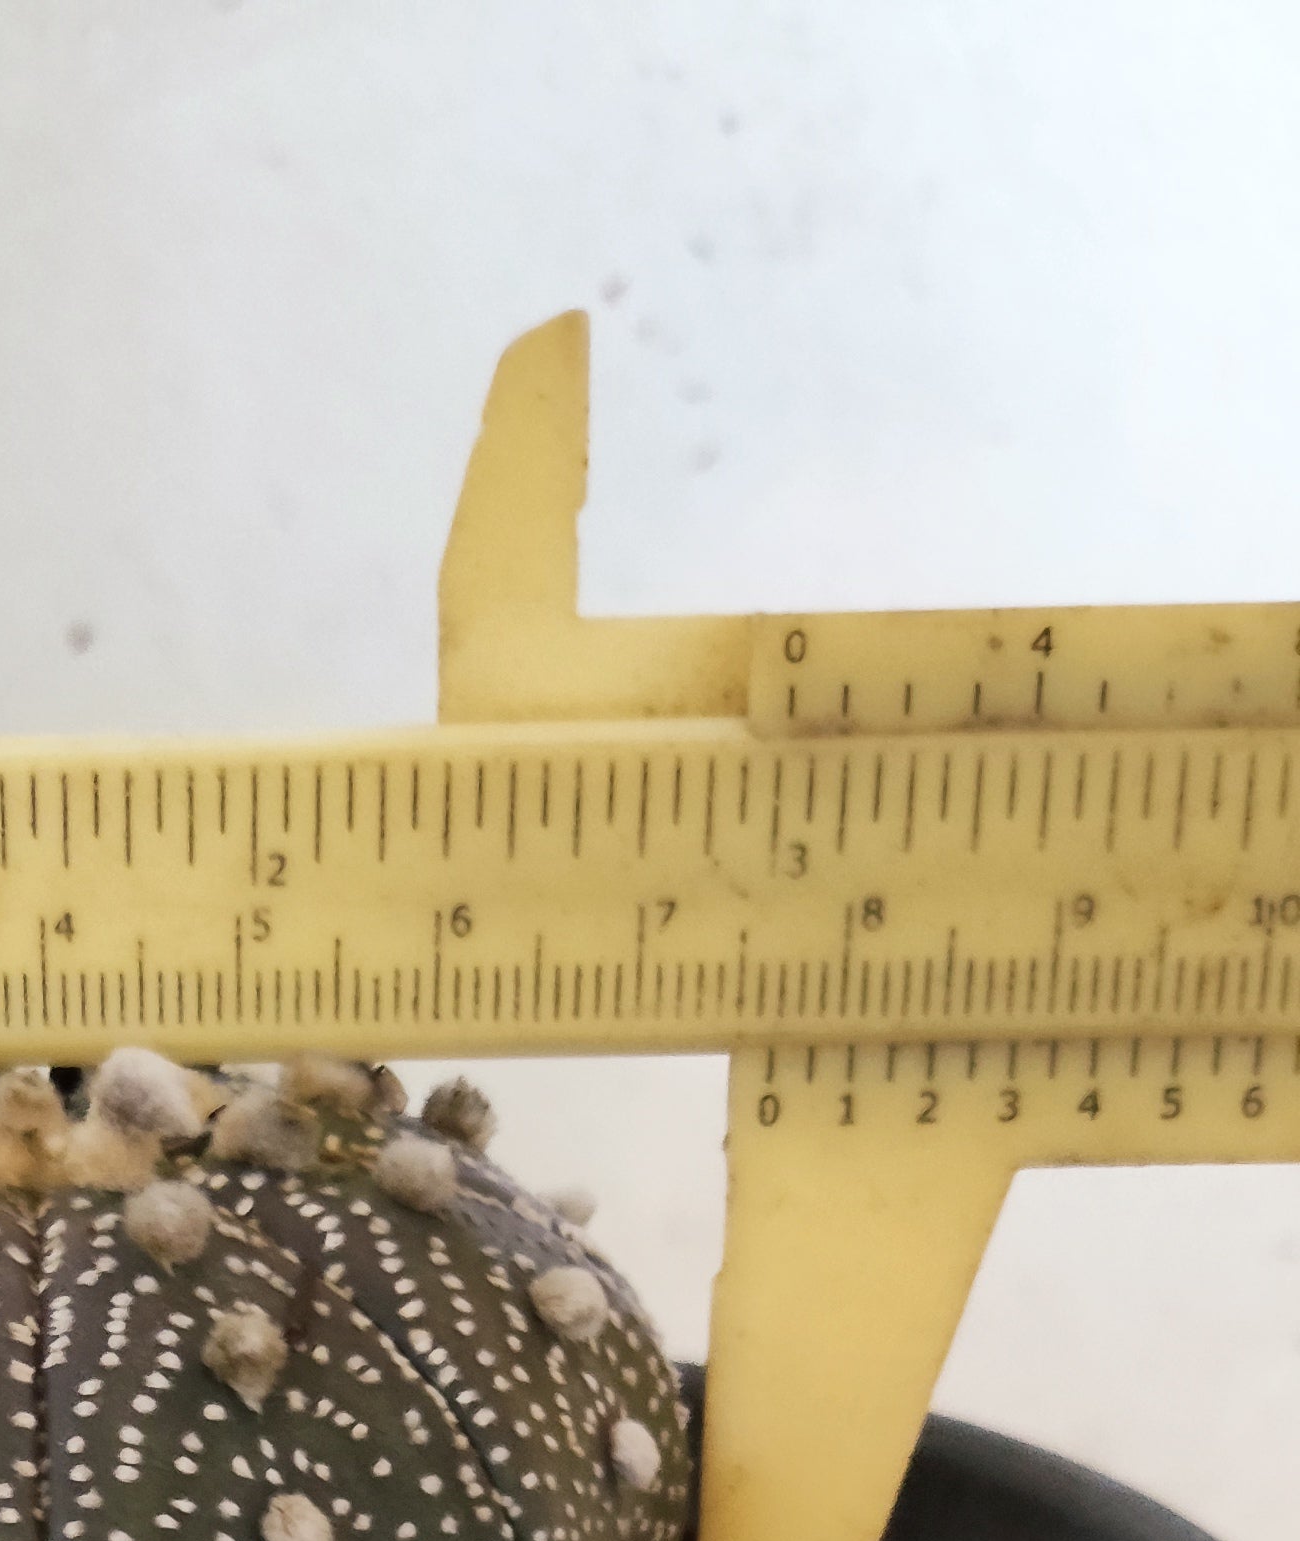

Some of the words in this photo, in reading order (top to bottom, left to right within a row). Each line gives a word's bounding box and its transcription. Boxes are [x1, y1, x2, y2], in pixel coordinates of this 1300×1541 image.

[785, 630, 807, 664] 0
[1031, 626, 1054, 659] 4
[267, 854, 287, 887] 2
[788, 844, 808, 879] 3
[54, 911, 75, 942] 4
[251, 907, 272, 941] 5
[450, 903, 472, 937] 6
[657, 900, 677, 925] 7
[862, 897, 886, 931] 8
[1073, 894, 1095, 926] 9
[757, 1093, 780, 1127] 0
[839, 1094, 856, 1126] 1
[916, 1091, 939, 1125] 2
[998, 1089, 1019, 1123] 3
[1077, 1088, 1101, 1120] 4
[1160, 1087, 1182, 1120] 5
[1241, 1086, 1265, 1119] 6
